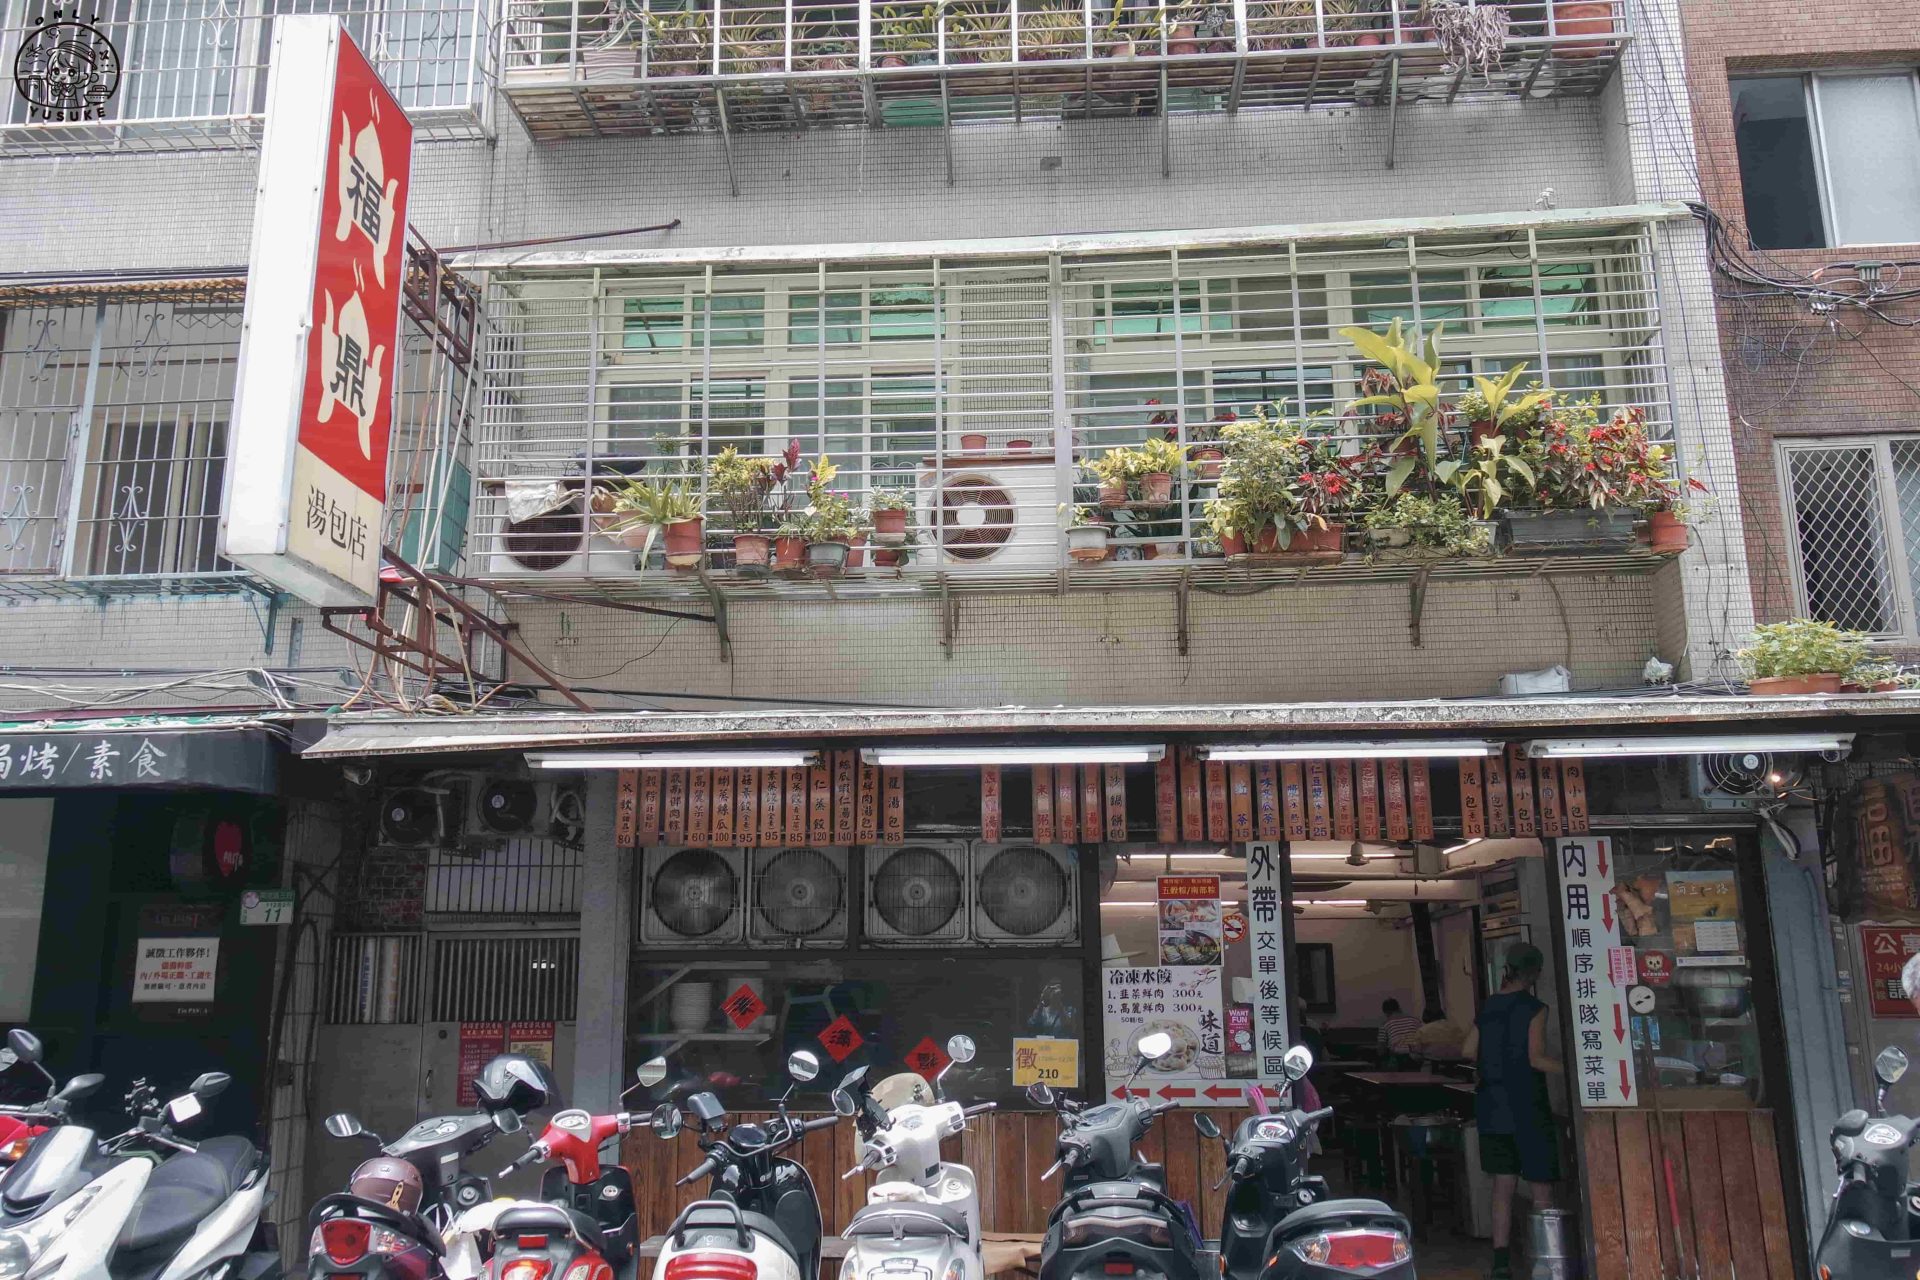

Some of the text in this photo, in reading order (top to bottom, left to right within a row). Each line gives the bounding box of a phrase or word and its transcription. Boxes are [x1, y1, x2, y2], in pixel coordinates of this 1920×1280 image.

[330, 157, 385, 417] 福鼎
[306, 485, 367, 561] 湯包店
[1490, 756, 1504, 821] 豆包(素)
[1110, 764, 1123, 827] 沙鍋餅
[1463, 759, 1481, 834] 泥包(素) 13
[886, 765, 901, 842] 籠湯包 85
[1289, 825, 1304, 836] 18
[1520, 823, 1533, 833] 13
[1544, 822, 1559, 832] 15
[1572, 821, 1586, 831] 15
[691, 832, 706, 842] 60
[714, 832, 729, 842] 100
[764, 831, 778, 841] 95
[789, 832, 803, 842] 85
[812, 832, 827, 841] 120
[837, 832, 852, 841] 140
[860, 830, 874, 840] 85
[1038, 827, 1051, 838] 25
[1236, 828, 1250, 838] 15
[1263, 827, 1277, 837] 15
[1313, 827, 1328, 837] 25
[618, 834, 631, 844] 80
[739, 833, 753, 842] 95
[264, 908, 282, 923] 11
[1109, 968, 1172, 985] 冷凍水餃
[1231, 1016, 1248, 1024] FUN
[1198, 1010, 1223, 1055] 味道
[1015, 1047, 1037, 1070] 徵
[1038, 1068, 1059, 1079] 210
